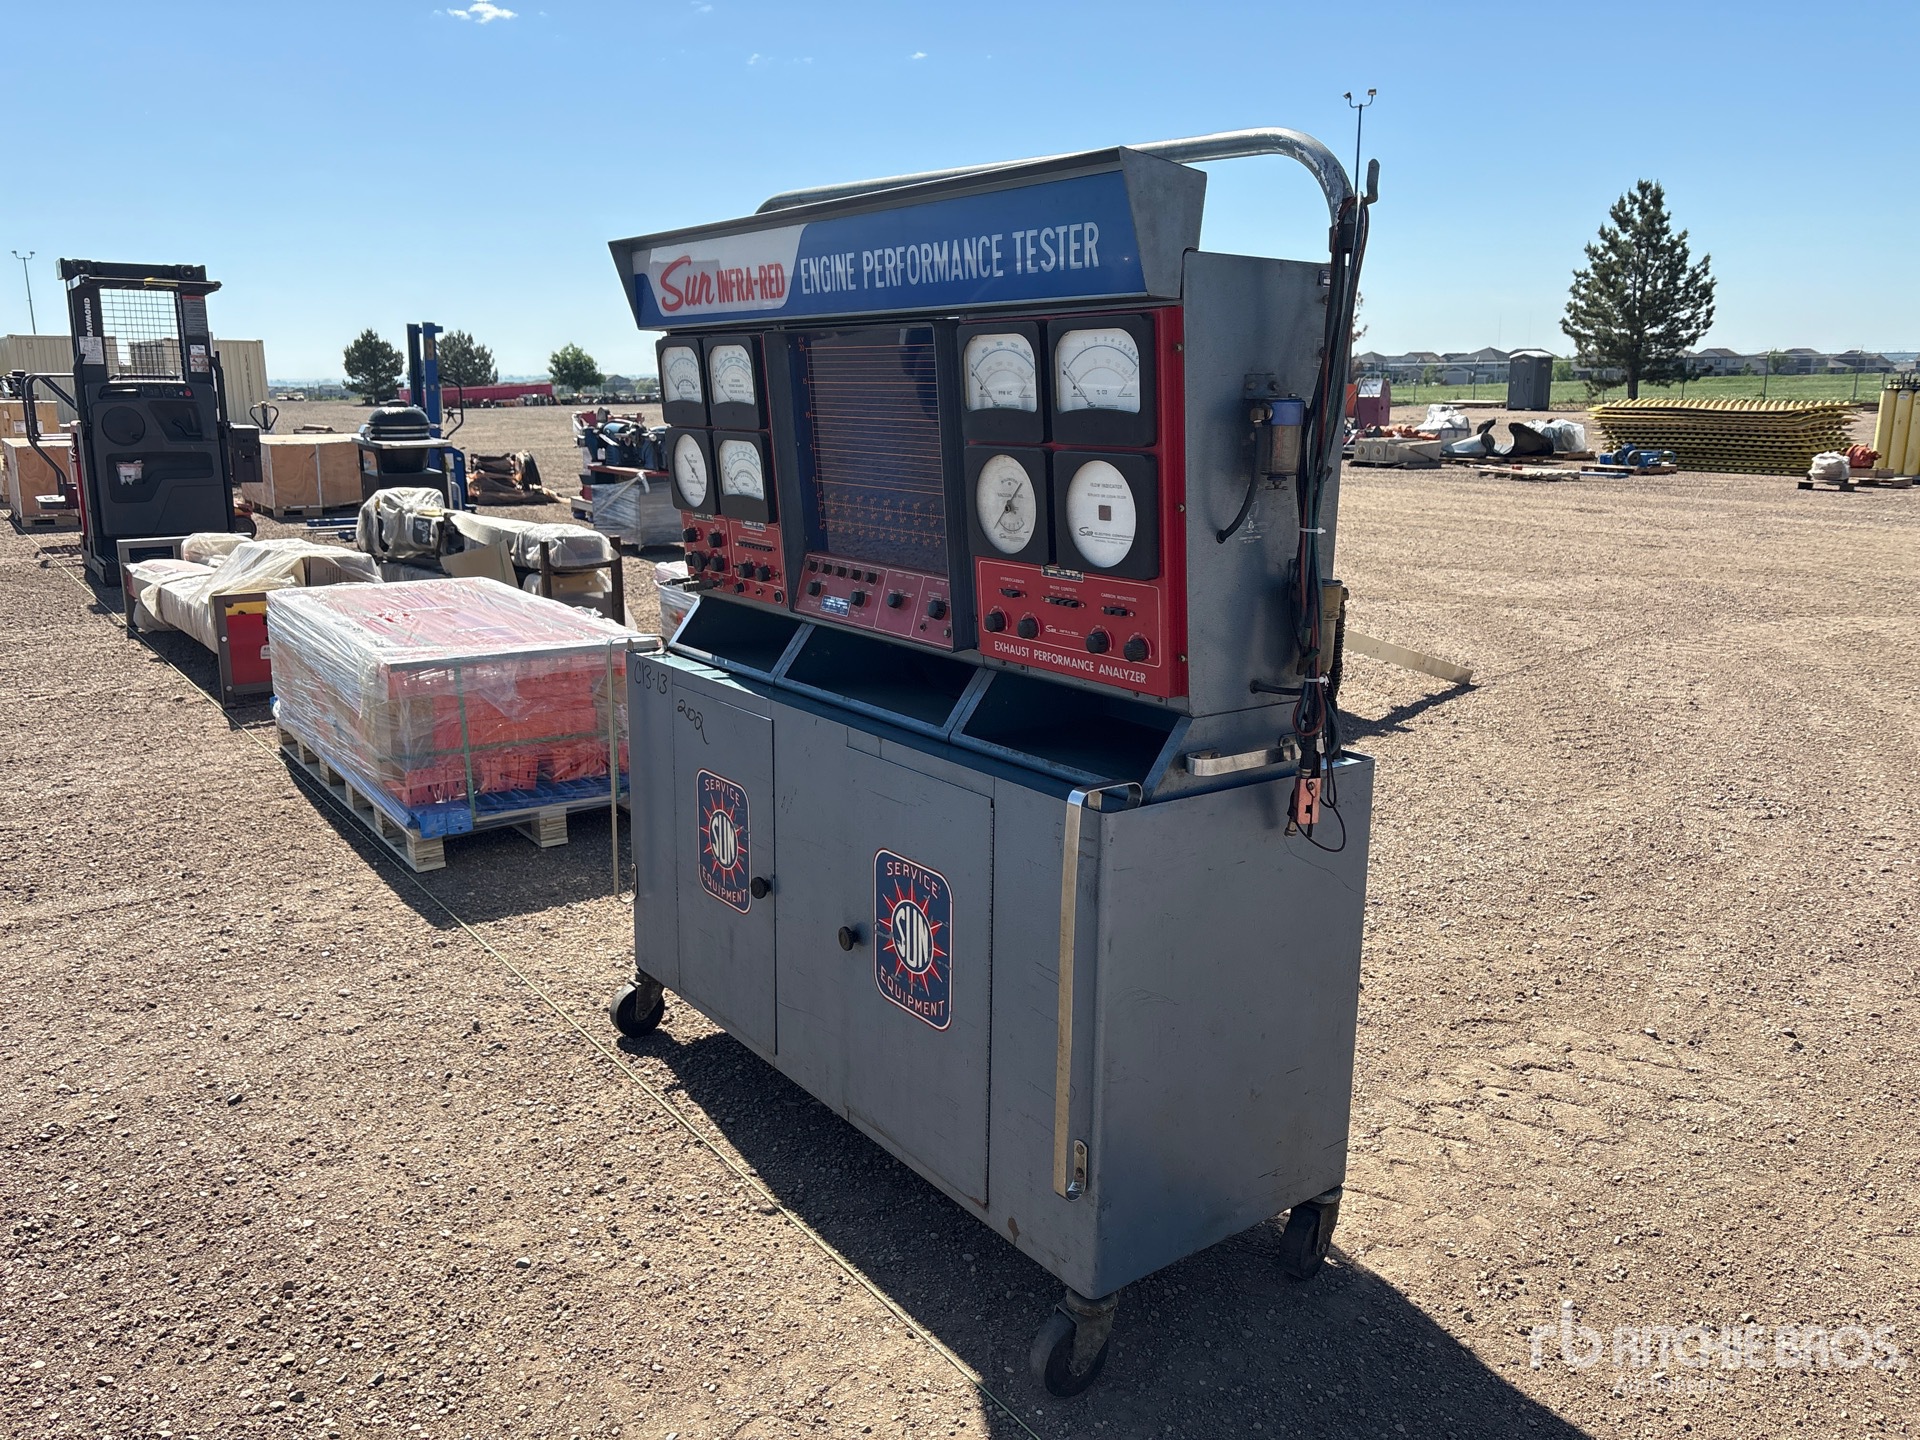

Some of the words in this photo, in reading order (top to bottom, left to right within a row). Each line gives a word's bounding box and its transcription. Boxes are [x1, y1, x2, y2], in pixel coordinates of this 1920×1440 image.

[800, 252, 857, 295] ENGINE
[862, 234, 1004, 289] PERFORMANCE
[1011, 221, 1100, 275] TESTER
[660, 255, 714, 312] Sun
[716, 263, 786, 304] INFRA-RED
[1078, 526, 1094, 537] Sun
[1060, 585, 1077, 593] CONTROL
[1100, 592, 1116, 600] CARBON
[994, 640, 1030, 658] EXHAUST
[1033, 649, 1094, 673] PERFORMANCE
[1098, 664, 1147, 685] ANALYZER
[704, 778, 741, 807] SERVICE
[711, 814, 735, 866] SUN
[702, 866, 747, 903] EQUIPMENT
[886, 861, 938, 900] SERVICE
[895, 905, 929, 969] SUN
[880, 964, 945, 1017] EQUIPMENT
